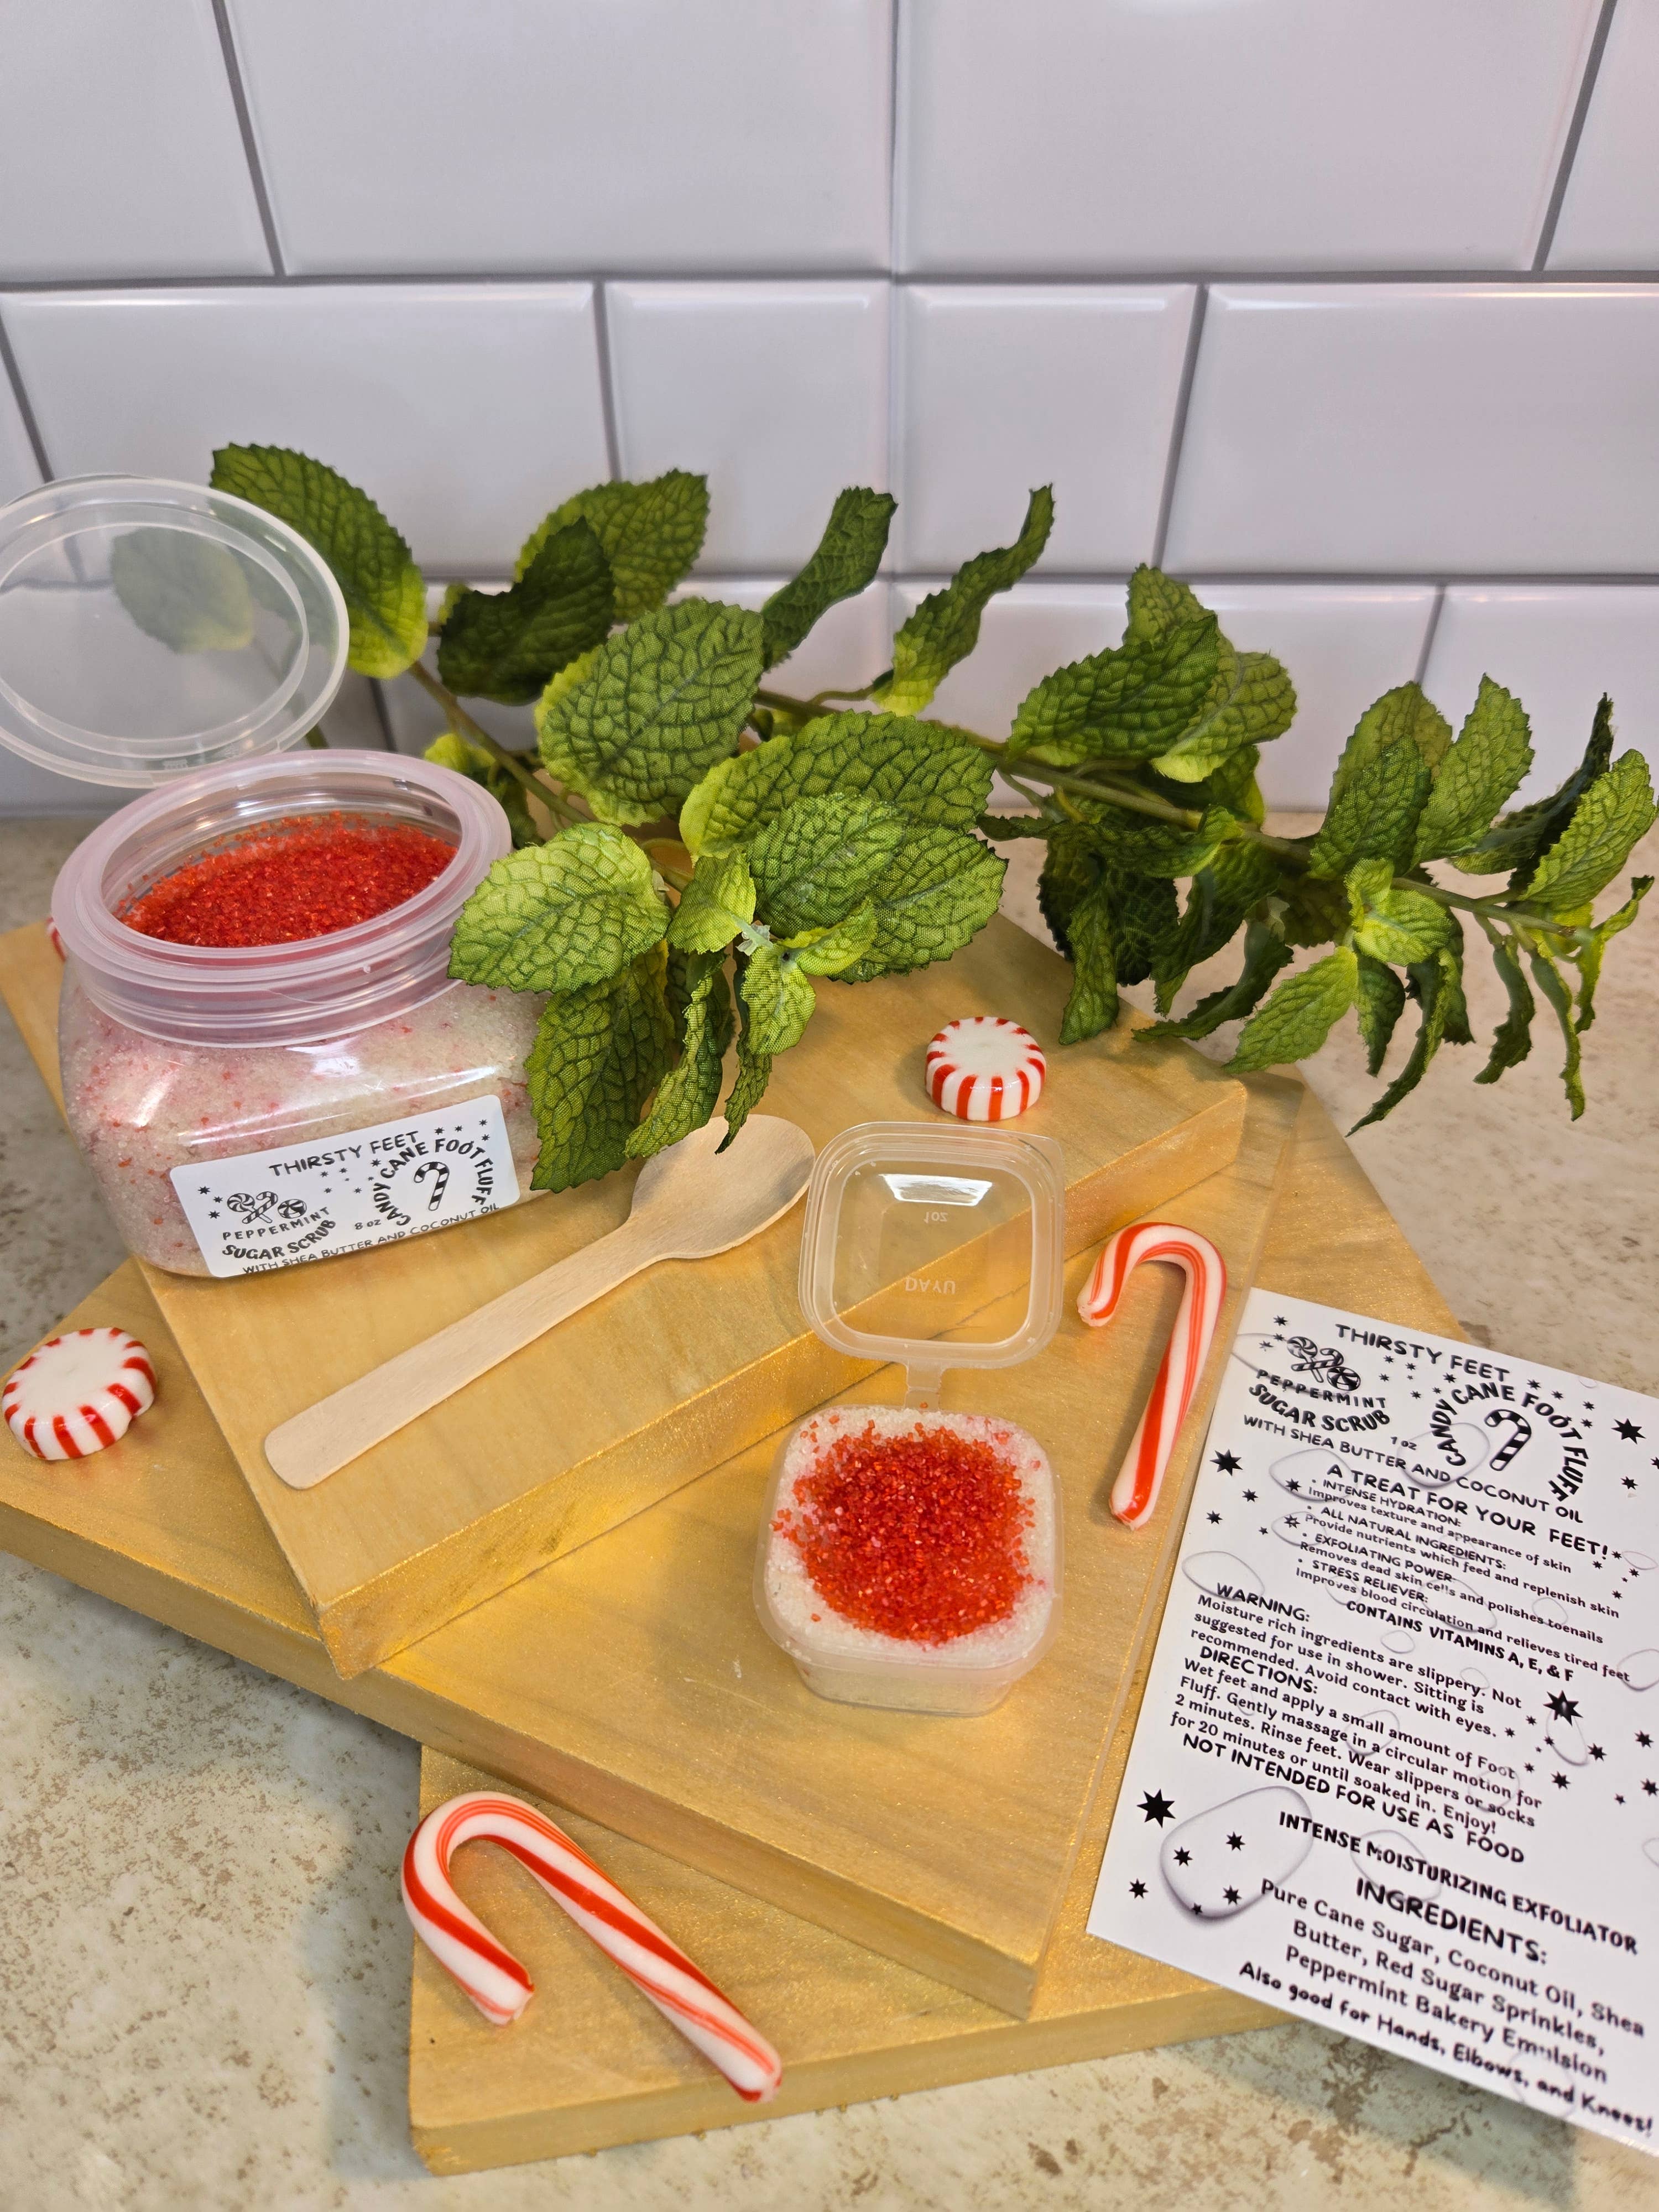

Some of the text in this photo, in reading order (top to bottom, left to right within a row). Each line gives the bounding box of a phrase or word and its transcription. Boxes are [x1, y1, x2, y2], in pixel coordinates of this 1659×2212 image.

[269, 1130, 419, 1177] THIRSTY FEET
[373, 1138, 493, 1227] CANDY CANE FOOT FLUFF
[222, 1207, 330, 1241] PEPPERMINT
[222, 1219, 337, 1260] SUGAR SCRUB
[242, 1202, 500, 1274] WITH SHEA BUTTER AND COCONUT OIL
[354, 1221, 364, 1231] 8
[1256, 1369, 1386, 1408] PEPPERMINT
[1335, 1323, 1510, 1381] THIRSTY FEET
[1249, 1384, 1390, 1432] SUGAR SCRUB
[1430, 1383, 1589, 1501] CANDY CANE FOOT FLUFF
[1244, 1415, 1583, 1523] WITH SHEA BUTTER AND COCONUT OIL
[1323, 1479, 1377, 1502] INTENSE
[1327, 1464, 1608, 1559] A TREAT FOR YOUR FEET!
[1308, 1487, 1571, 1573] Improves texture and of skin
[1315, 1533, 1401, 1567] EXFOLIATING
[1321, 1507, 1506, 1570] ALL NATURAL INGREDIENTS:
[1217, 1583, 1310, 1622] WARNING:
[1300, 1541, 1603, 1644] Removes dead skin and polishes toenails
[1312, 1560, 1428, 1603] STRESS RELIEVER:
[1357, 1531, 1619, 1619] nutrients which feed and replenish skin
[1194, 1614, 1484, 1714] suggested for use in shower. Sitting is
[1198, 1594, 1522, 1709] Moisture rich ingredients are slippery. Not
[1296, 1567, 1630, 1682] Improves blood and relieves tired feet
[1346, 1600, 1574, 1682] CONTAINS VITAMINS A, E, & F
[1185, 1657, 1473, 1768] Wet feet and apply a small amount of
[1191, 1629, 1496, 1737] recommended. Avoid contact with eyes.
[1199, 1646, 1318, 1694] DIRECTIONS:
[1170, 1711, 1496, 1835] for 20 minutes or until soaked in. Enjoy!
[1175, 1693, 1459, 1800] 2 minutes. Rinse feet. Wear slippers
[1180, 1676, 1542, 1808] Fluff. Gently massage in a circular for
[1183, 1733, 1524, 1863] NOT INTENDED FOR USE AS FOOD
[1279, 1811, 1637, 1955] INTENSE MOISTURIZING EXFOLIATOR
[1356, 1877, 1546, 1964] INGREDIENTS:
[1239, 1961, 1370, 2022] Also good for
[1261, 1879, 1582, 2017] Pure Cane Sugar, Coconut Oil,
[1293, 1919, 1367, 1966] Butter,
[1376, 1950, 1413, 1979] Red
[1421, 1969, 1484, 2004] Sugar
[1286, 1945, 1494, 2043] Peppermint Bakery
